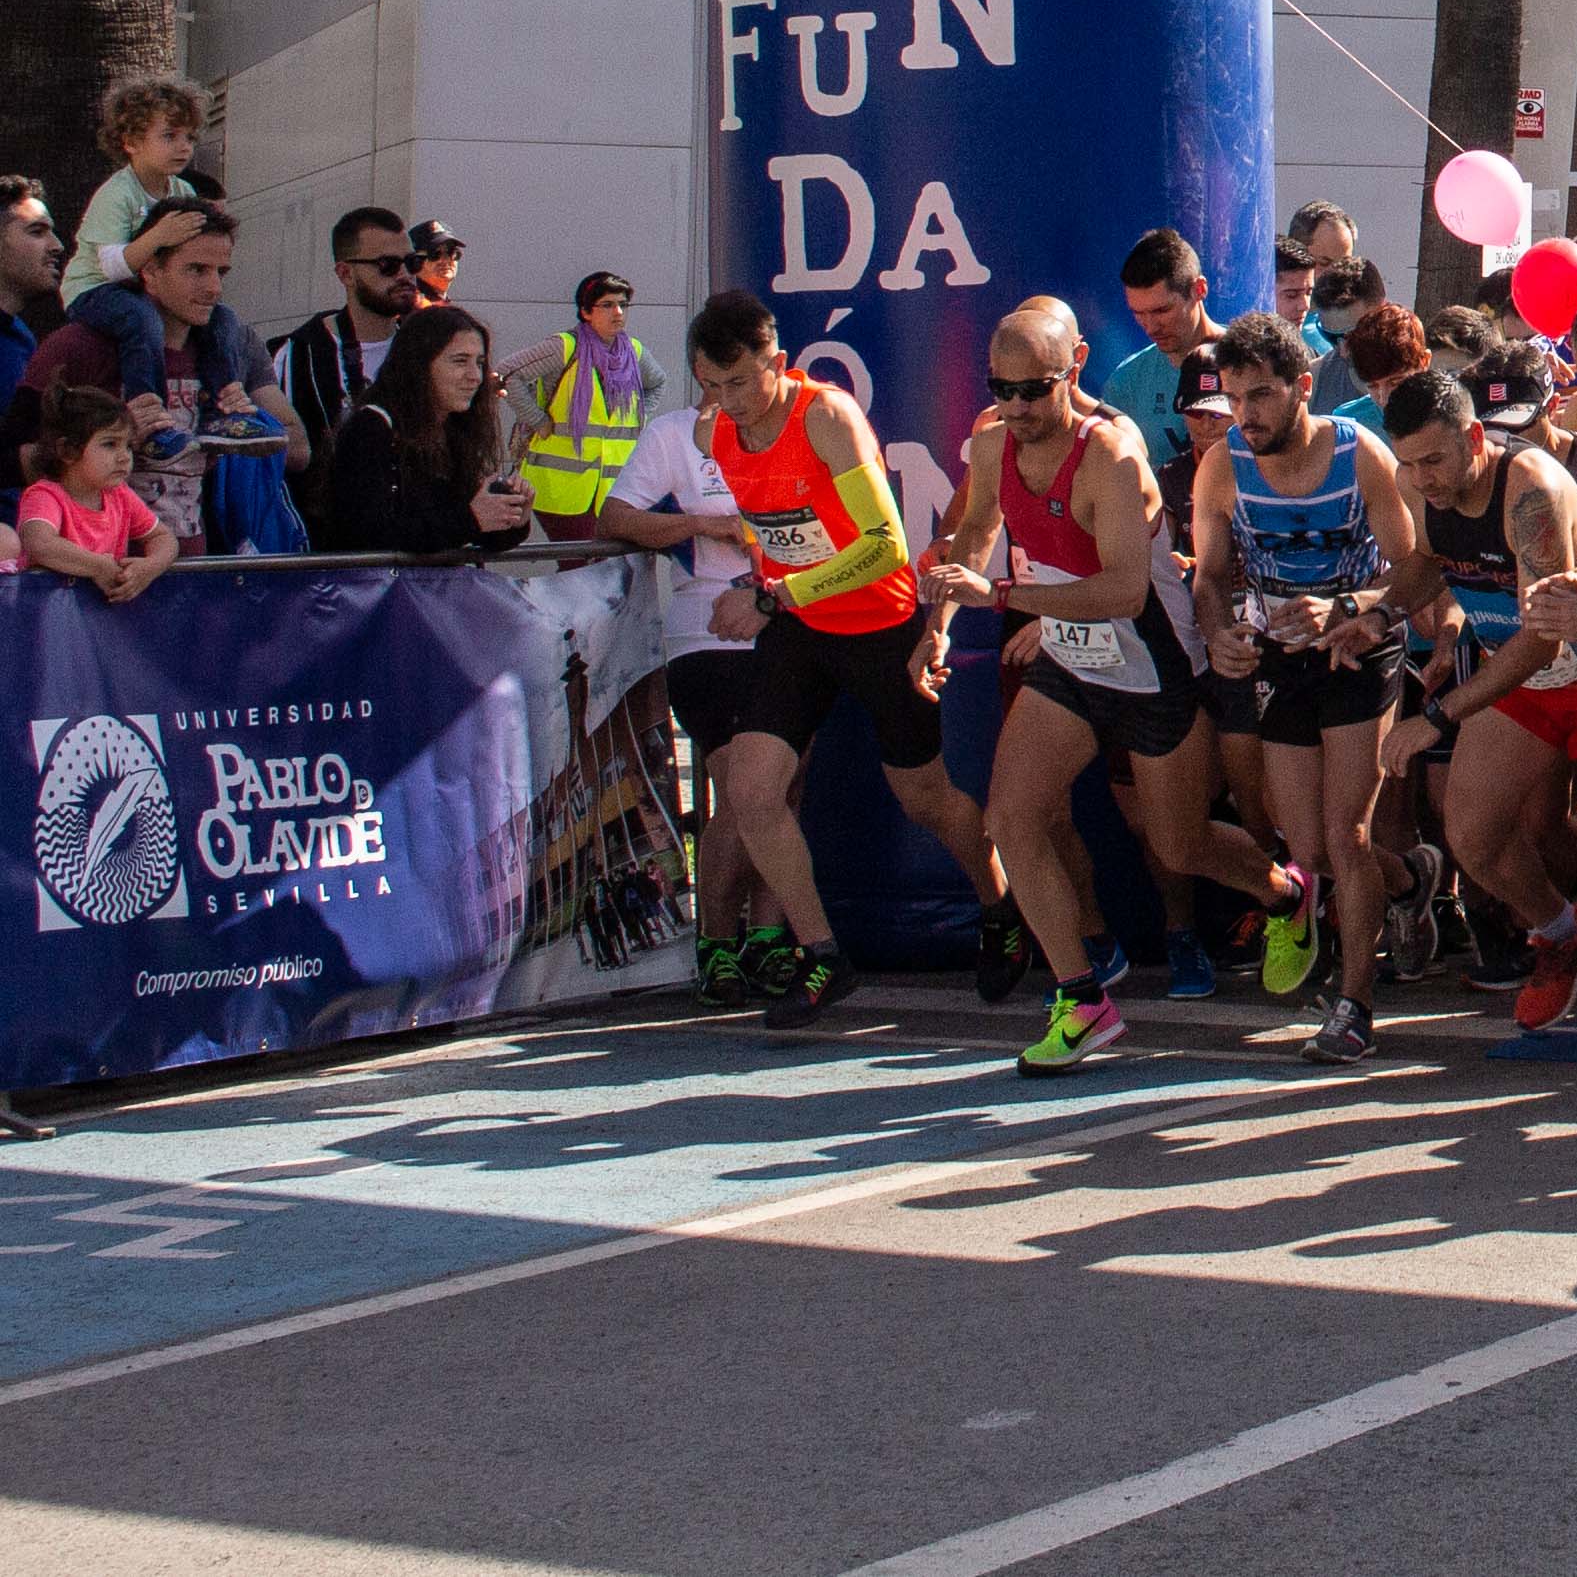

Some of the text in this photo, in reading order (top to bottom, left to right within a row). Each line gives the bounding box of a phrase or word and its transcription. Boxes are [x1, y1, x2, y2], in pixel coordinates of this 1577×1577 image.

[767, 153, 992, 293] DA
[761, 527, 806, 546] 286
[1055, 622, 1091, 646] 147
[175, 699, 373, 730] UNIVERSIDAD
[206, 743, 351, 812] PABLO
[197, 811, 386, 880] OLAVIDE
[206, 875, 392, 914] SEVILLA
[136, 954, 323, 998] Compromiso público
